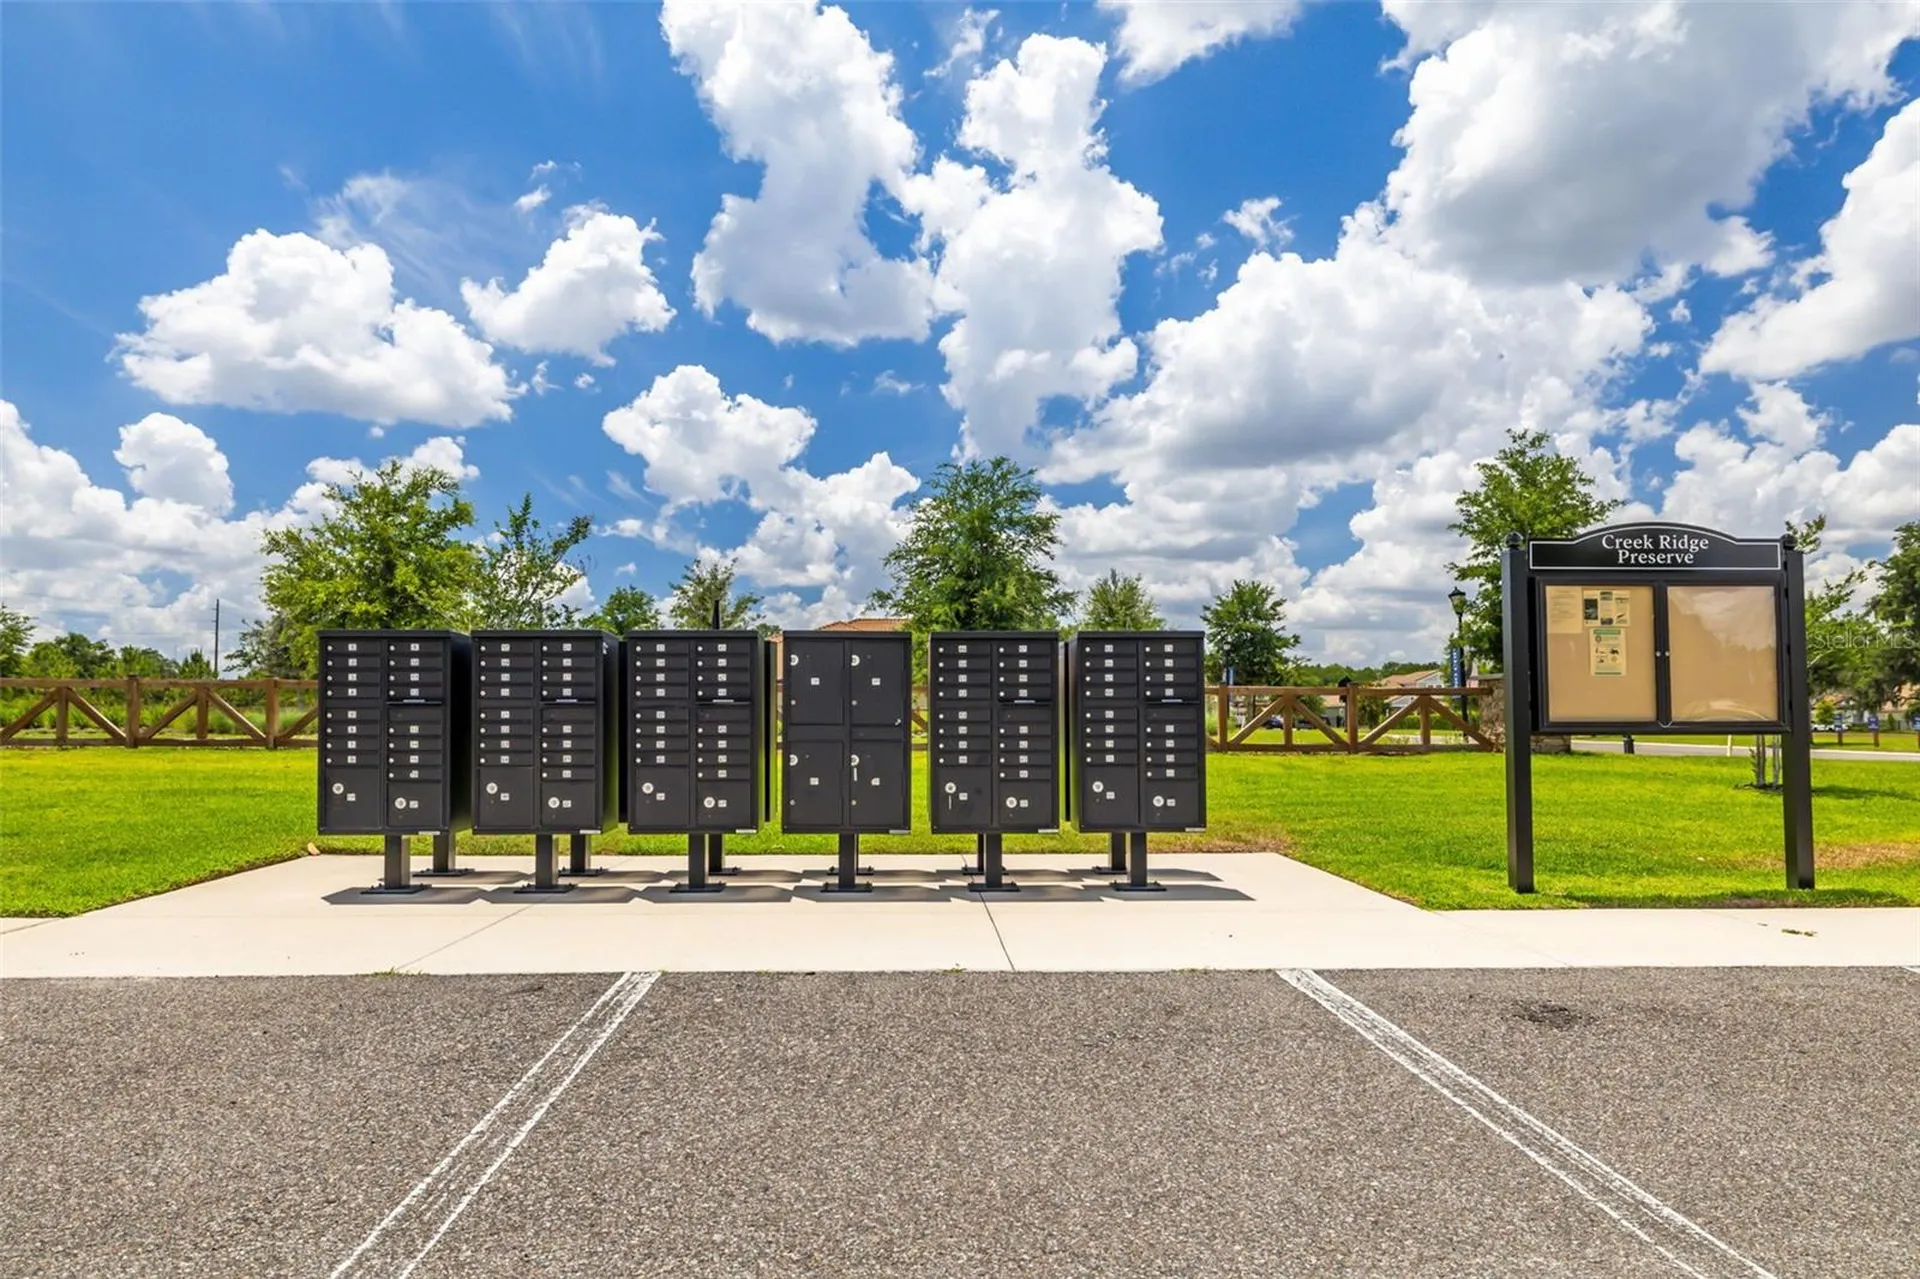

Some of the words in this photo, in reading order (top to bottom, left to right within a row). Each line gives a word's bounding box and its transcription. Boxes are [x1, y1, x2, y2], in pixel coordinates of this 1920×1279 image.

[1602, 534, 1654, 549] Creek
[1659, 534, 1709, 553] Ridge
[1618, 549, 1694, 564] Preserve
